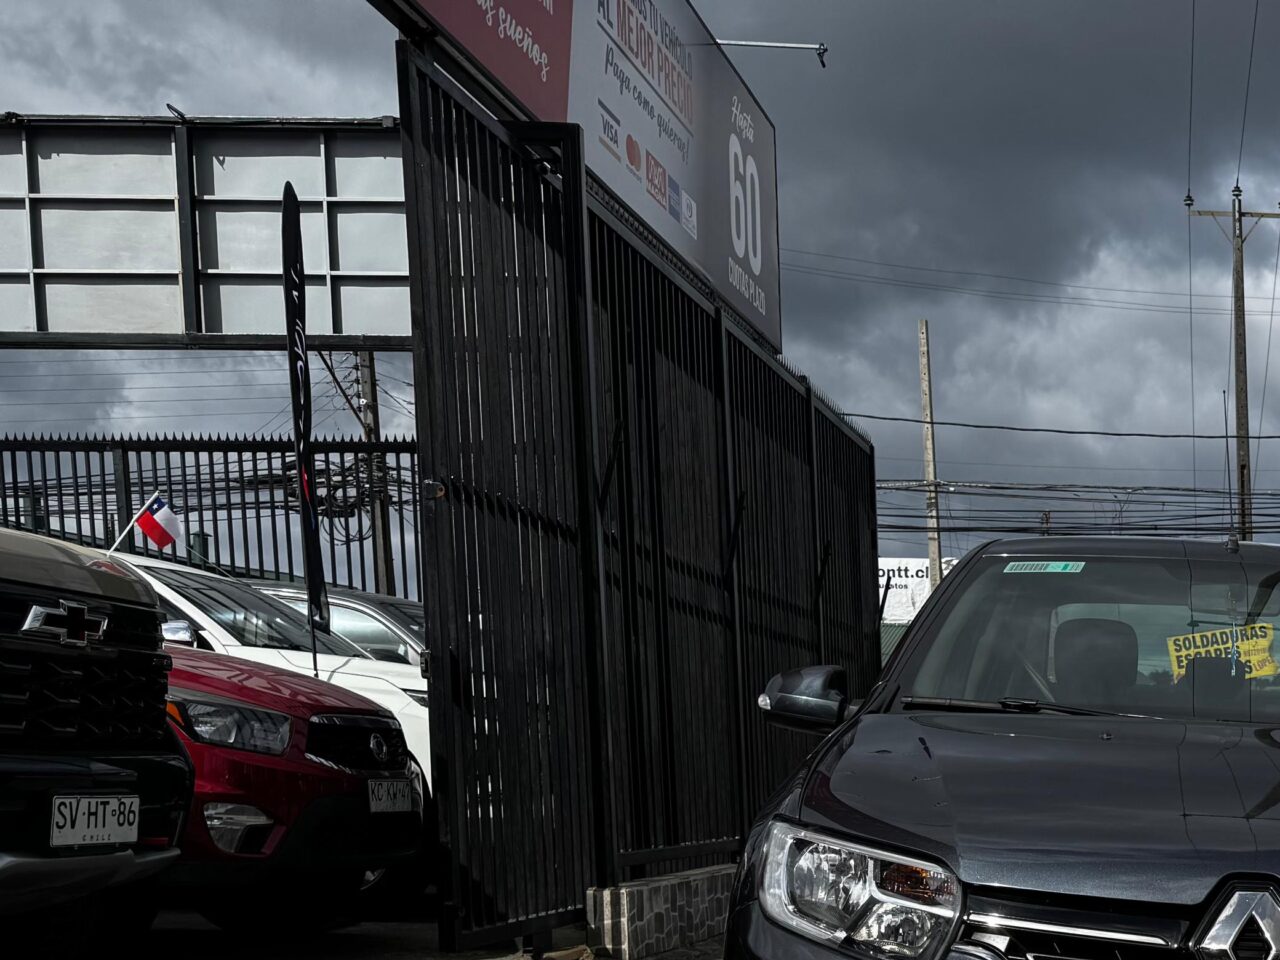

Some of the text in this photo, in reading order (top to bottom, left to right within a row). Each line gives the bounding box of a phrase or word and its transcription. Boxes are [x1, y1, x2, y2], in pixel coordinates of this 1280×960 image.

[498, 7, 550, 82] sueños
[617, 0, 655, 80] MEJOR
[657, 43, 693, 126] PRECIO
[632, 85, 656, 120] como
[731, 95, 754, 144] Hasta
[601, 113, 619, 149] VISA
[729, 133, 761, 276] 60
[729, 256, 766, 316] CUOTAS PLAZO
[878, 566, 929, 579] ontt.cl
[1173, 625, 1268, 653] SOLDADURAS
